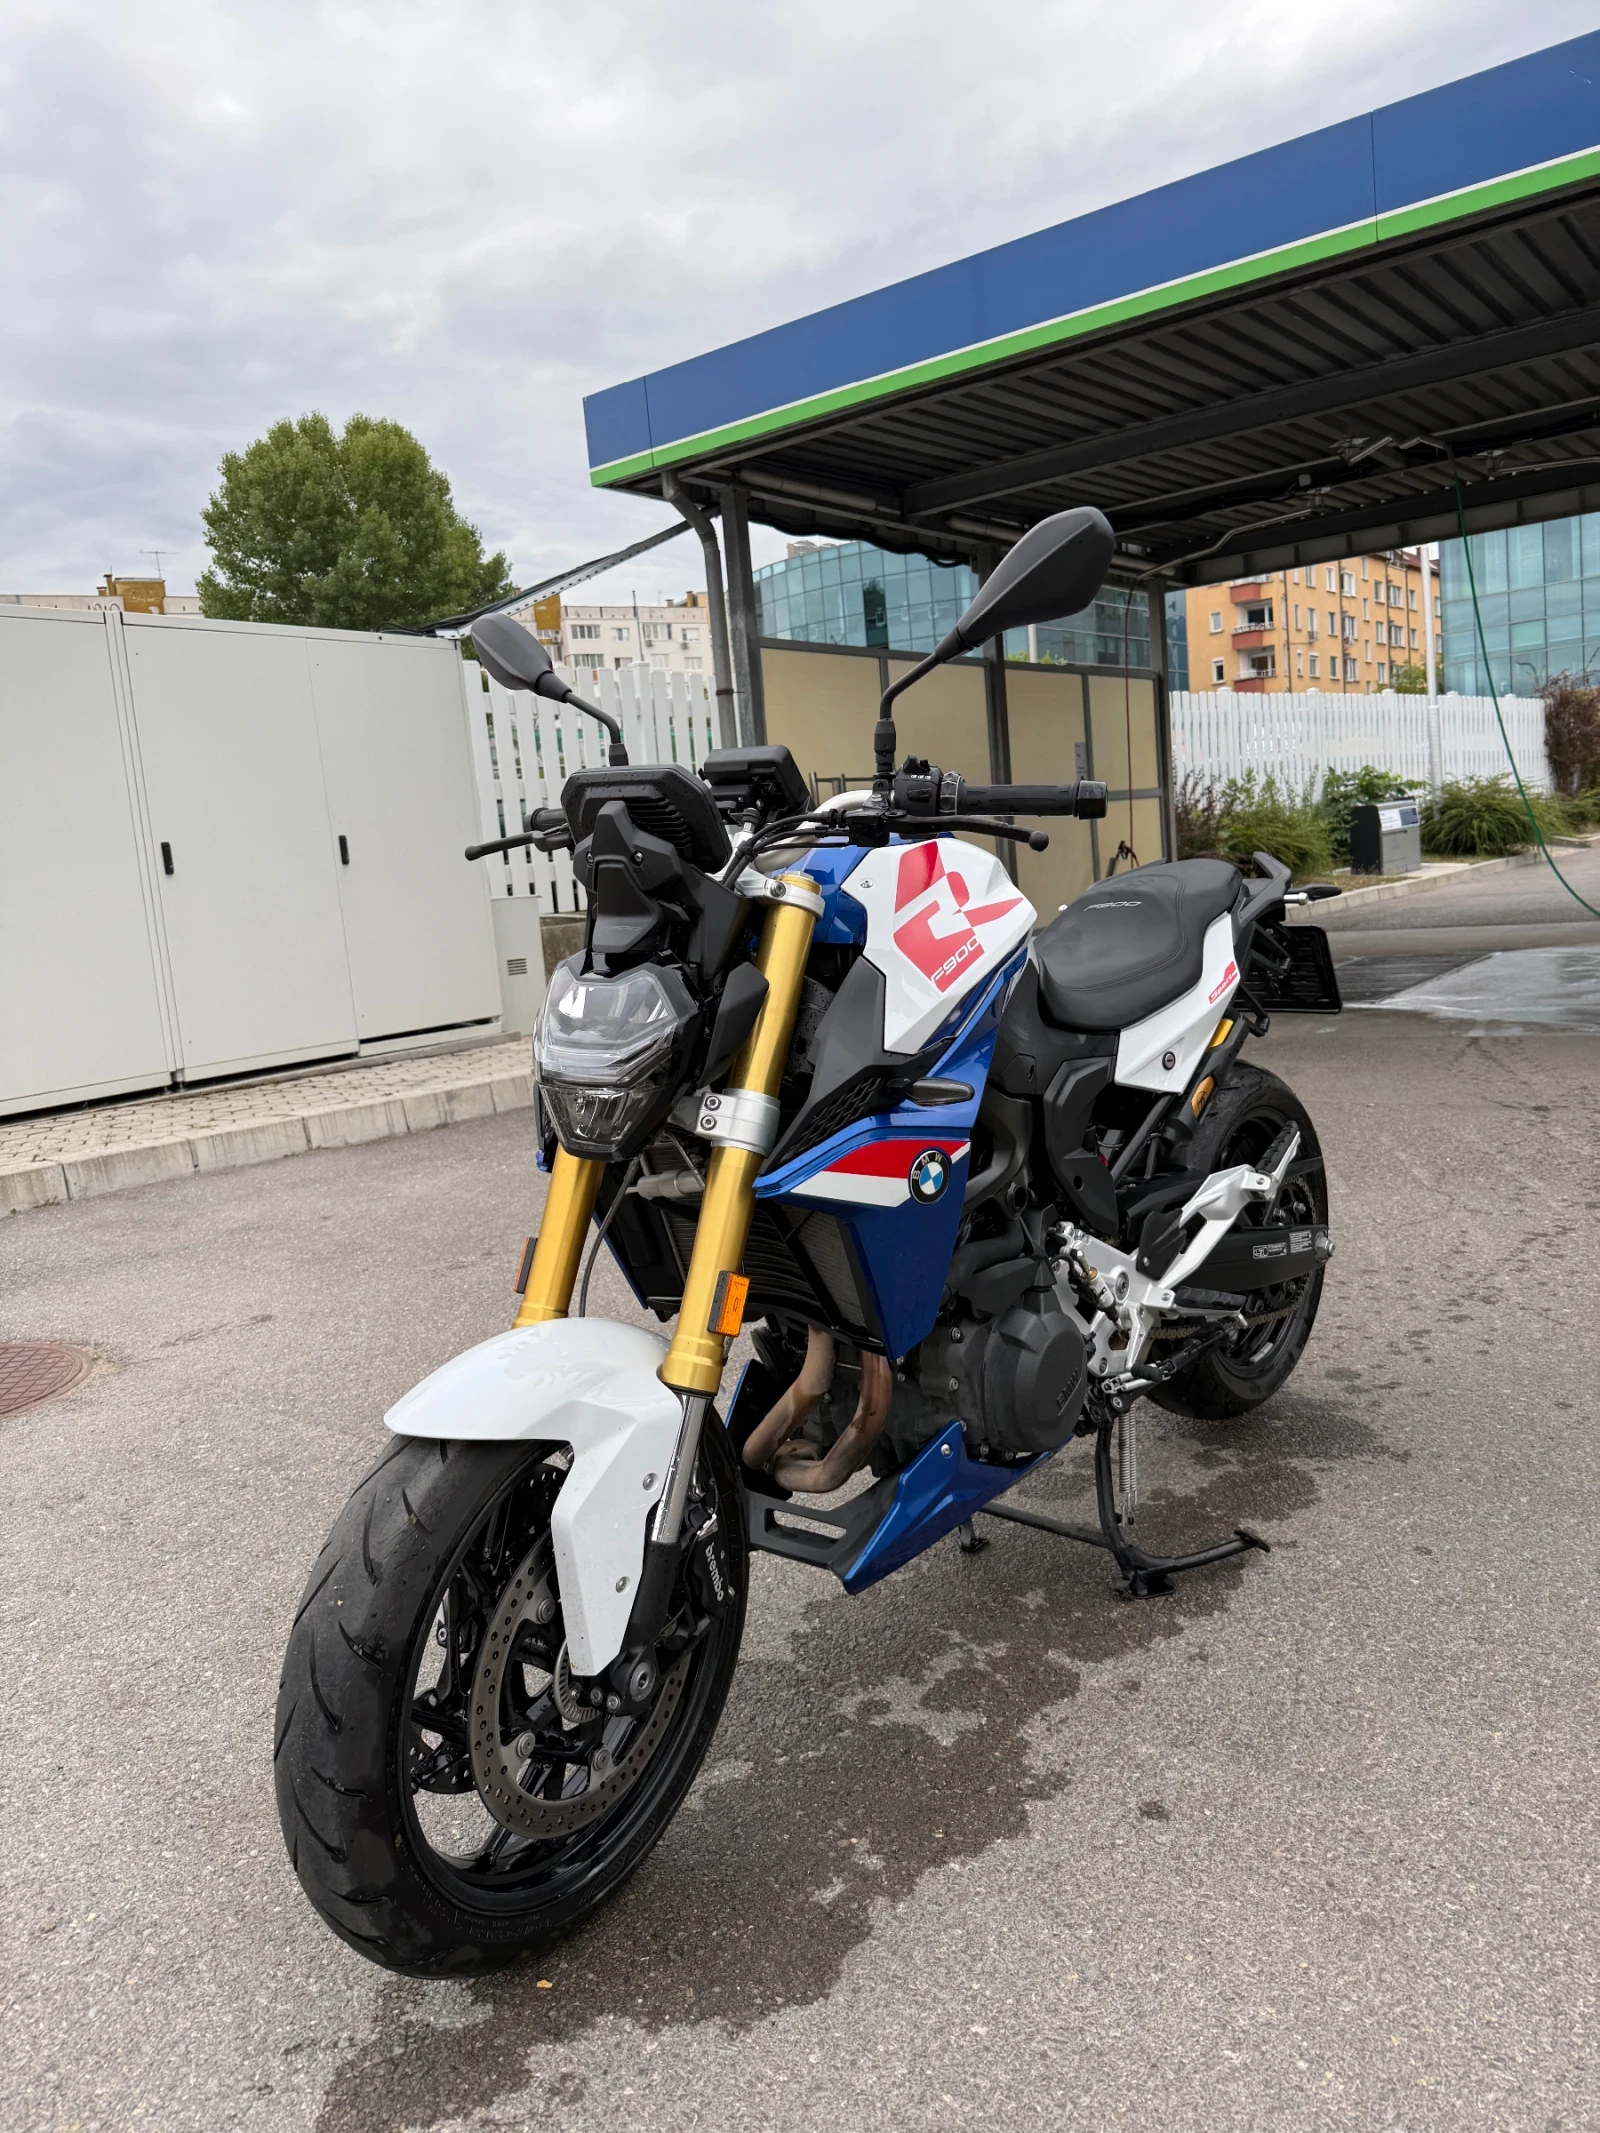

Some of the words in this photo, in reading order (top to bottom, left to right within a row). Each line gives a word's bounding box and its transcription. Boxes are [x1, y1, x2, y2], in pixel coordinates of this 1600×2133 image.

[931, 936, 981, 983] F900
[912, 1152, 943, 1180] BMW
[1056, 1367, 1081, 1410] BMW
[705, 1542, 724, 1601] brembo
